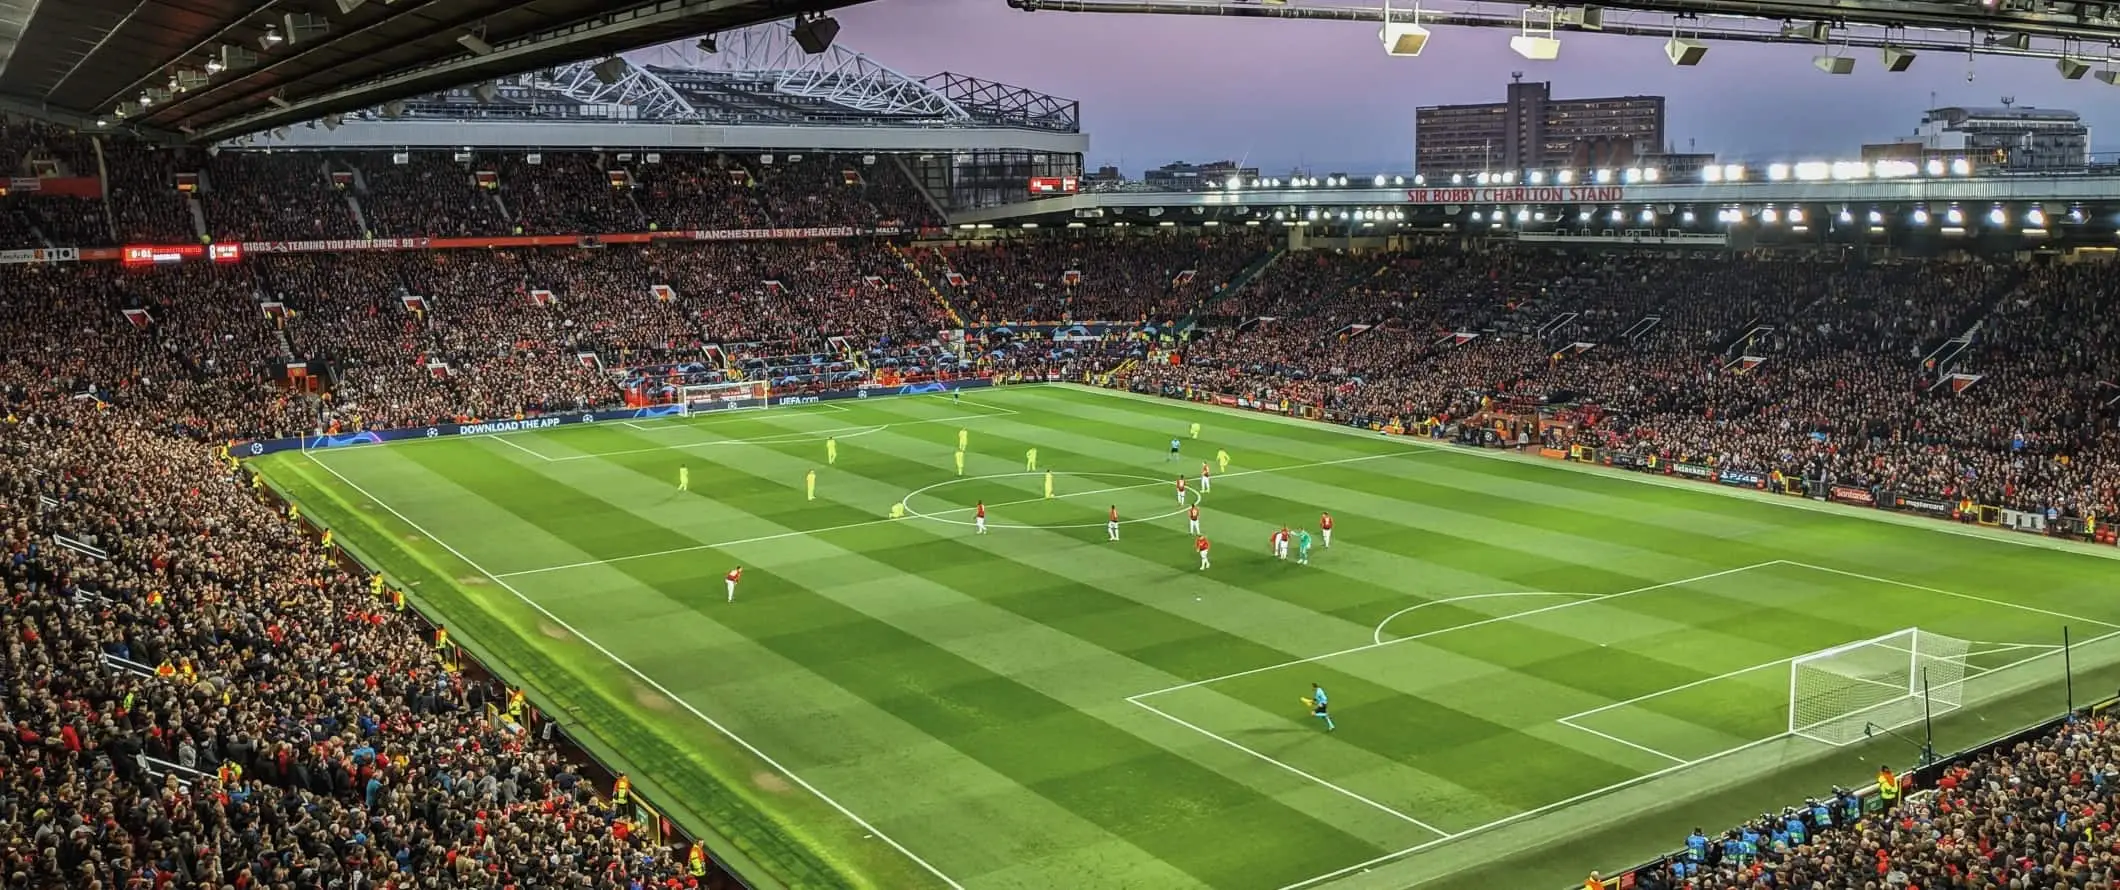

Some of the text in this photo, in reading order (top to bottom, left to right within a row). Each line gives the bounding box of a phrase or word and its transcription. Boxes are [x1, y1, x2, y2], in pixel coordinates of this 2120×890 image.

[1407, 187, 1624, 202] SIR BOBBY CHARLTON STAND
[696, 229, 770, 240] MANCHESTER
[772, 228, 784, 237] IS
[785, 228, 801, 237] MY
[243, 241, 272, 252] GIGGS
[288, 241, 325, 251] TEARING
[326, 240, 344, 250] YOU
[345, 239, 372, 249] APART
[373, 238, 398, 248] SINCE
[779, 396, 819, 406] UEFA.com
[460, 417, 561, 435] DOWNLOAD THE APP
